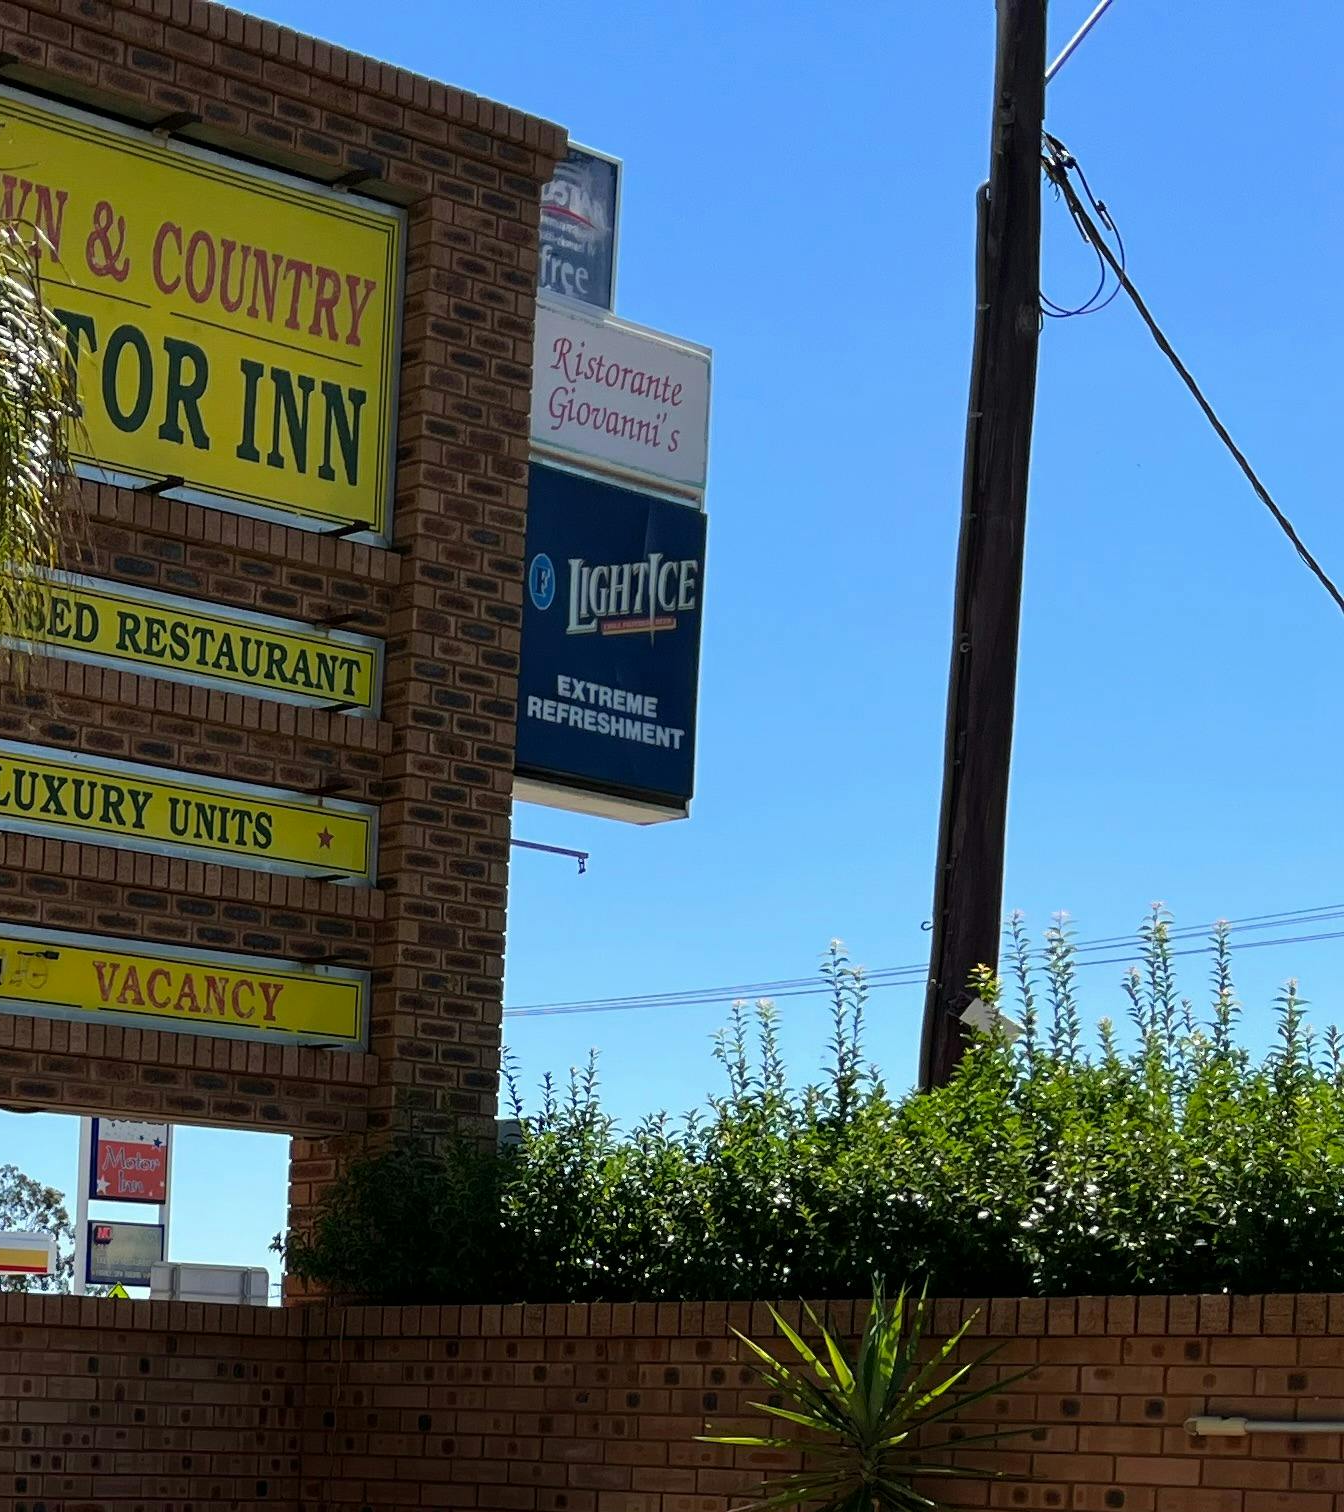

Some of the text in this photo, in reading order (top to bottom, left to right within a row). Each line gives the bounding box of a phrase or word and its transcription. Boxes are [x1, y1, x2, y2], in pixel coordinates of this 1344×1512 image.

[85, 200, 130, 283] &
[152, 221, 376, 348] COUNTRY
[541, 244, 589, 294] free
[550, 337, 684, 407] Ristorante
[237, 358, 367, 487] INN
[548, 386, 681, 453] Giovanni's
[115, 610, 361, 697] RESTAURANT
[527, 695, 685, 750] REFRESHMENT
[556, 674, 659, 719] EXTREME
[167, 797, 274, 850] UNITS
[92, 959, 284, 1022] VACANCY
[103, 1145, 160, 1171] Motor
[118, 1170, 144, 1193] Inn
